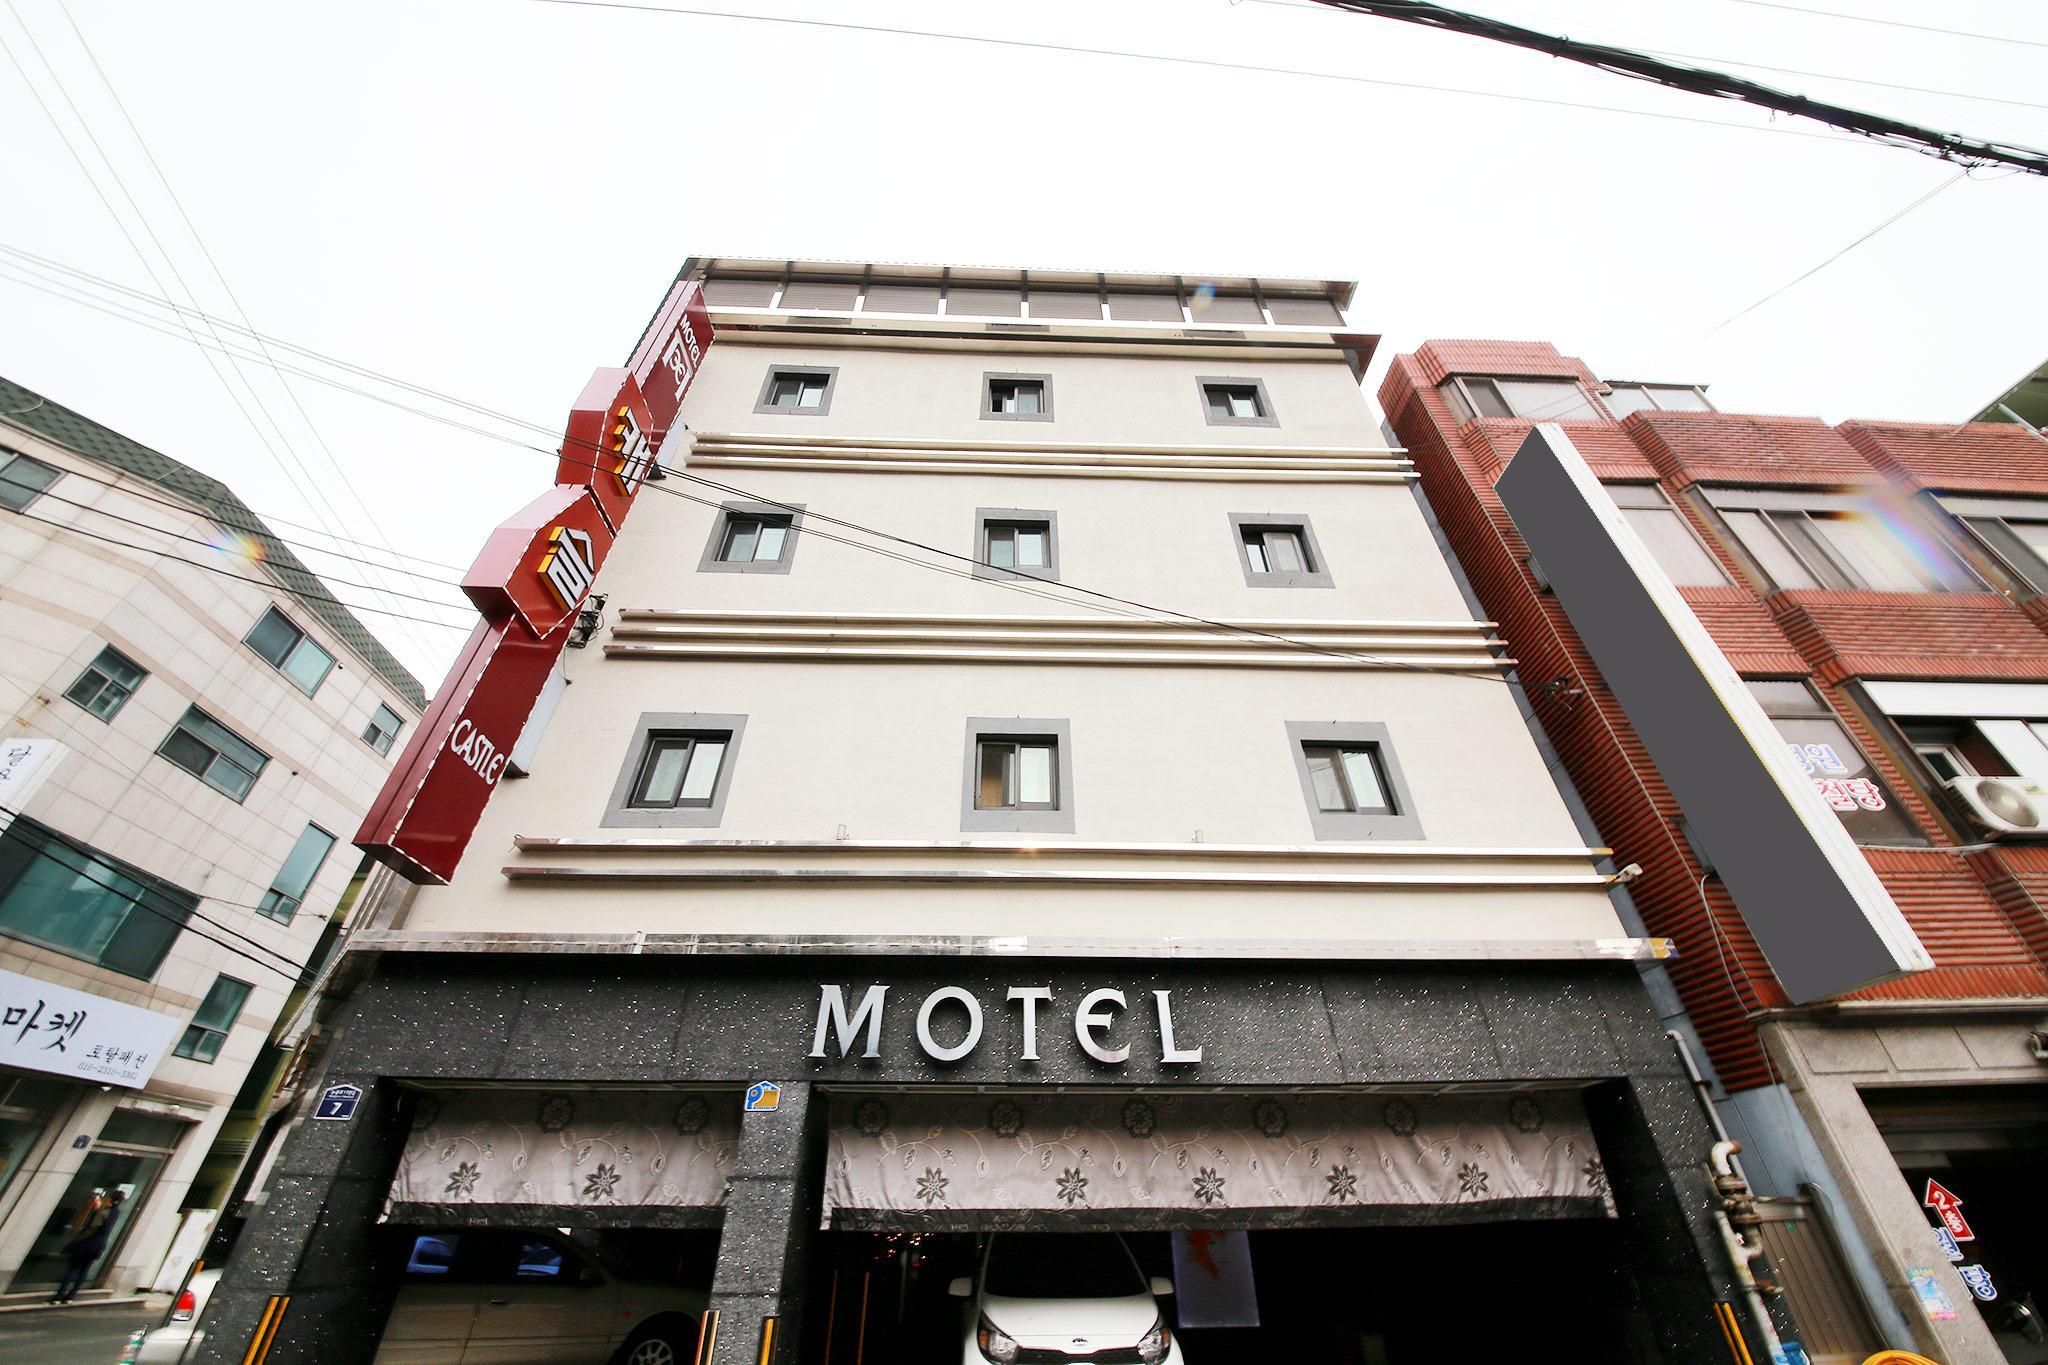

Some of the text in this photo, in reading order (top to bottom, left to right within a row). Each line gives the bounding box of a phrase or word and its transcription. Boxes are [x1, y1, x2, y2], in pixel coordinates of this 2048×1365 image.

[680, 313, 701, 369] MOTEL
[450, 719, 505, 785] CASTLE
[3, 999, 87, 1053] 마켓
[807, 983, 1203, 1063] MOTEL
[330, 1102, 343, 1115] 7
